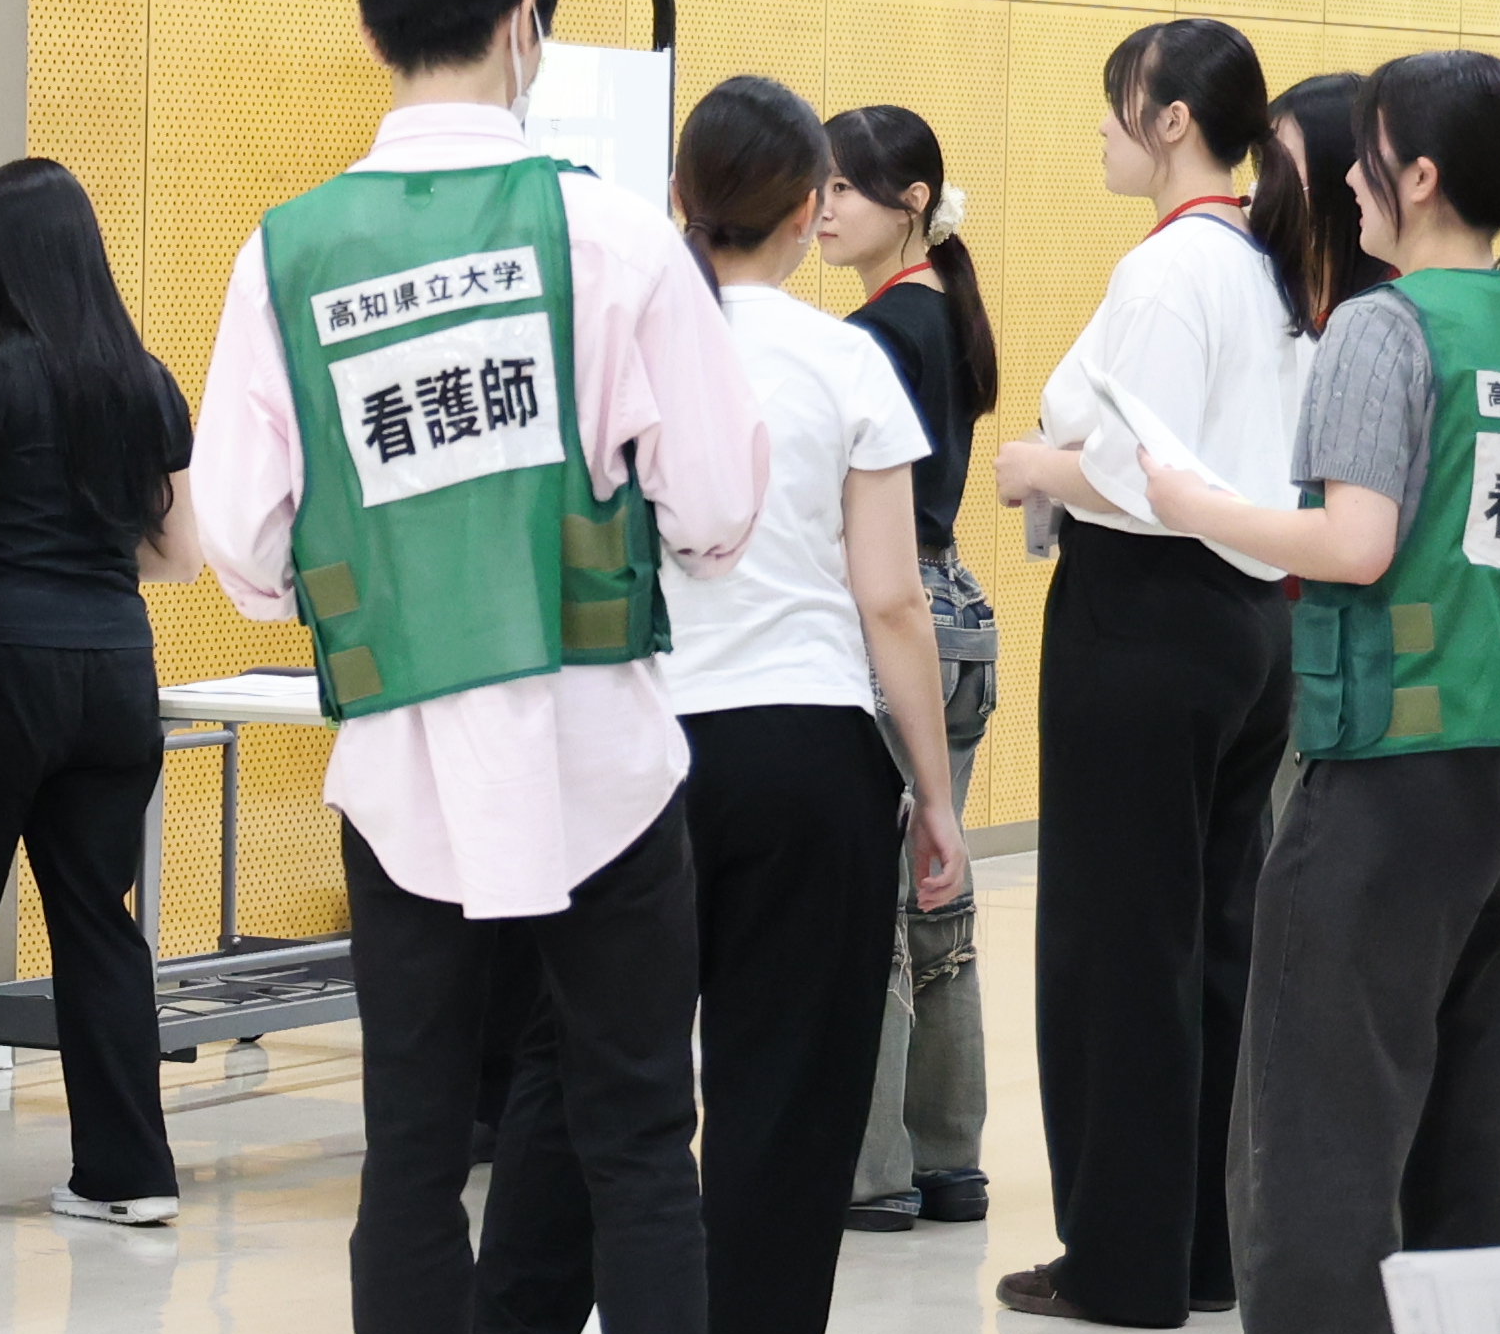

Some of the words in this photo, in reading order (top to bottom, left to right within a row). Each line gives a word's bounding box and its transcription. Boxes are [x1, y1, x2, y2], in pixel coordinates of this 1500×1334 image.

[325, 261, 524, 332] 高知県立大学
[362, 357, 540, 464] 看護師
